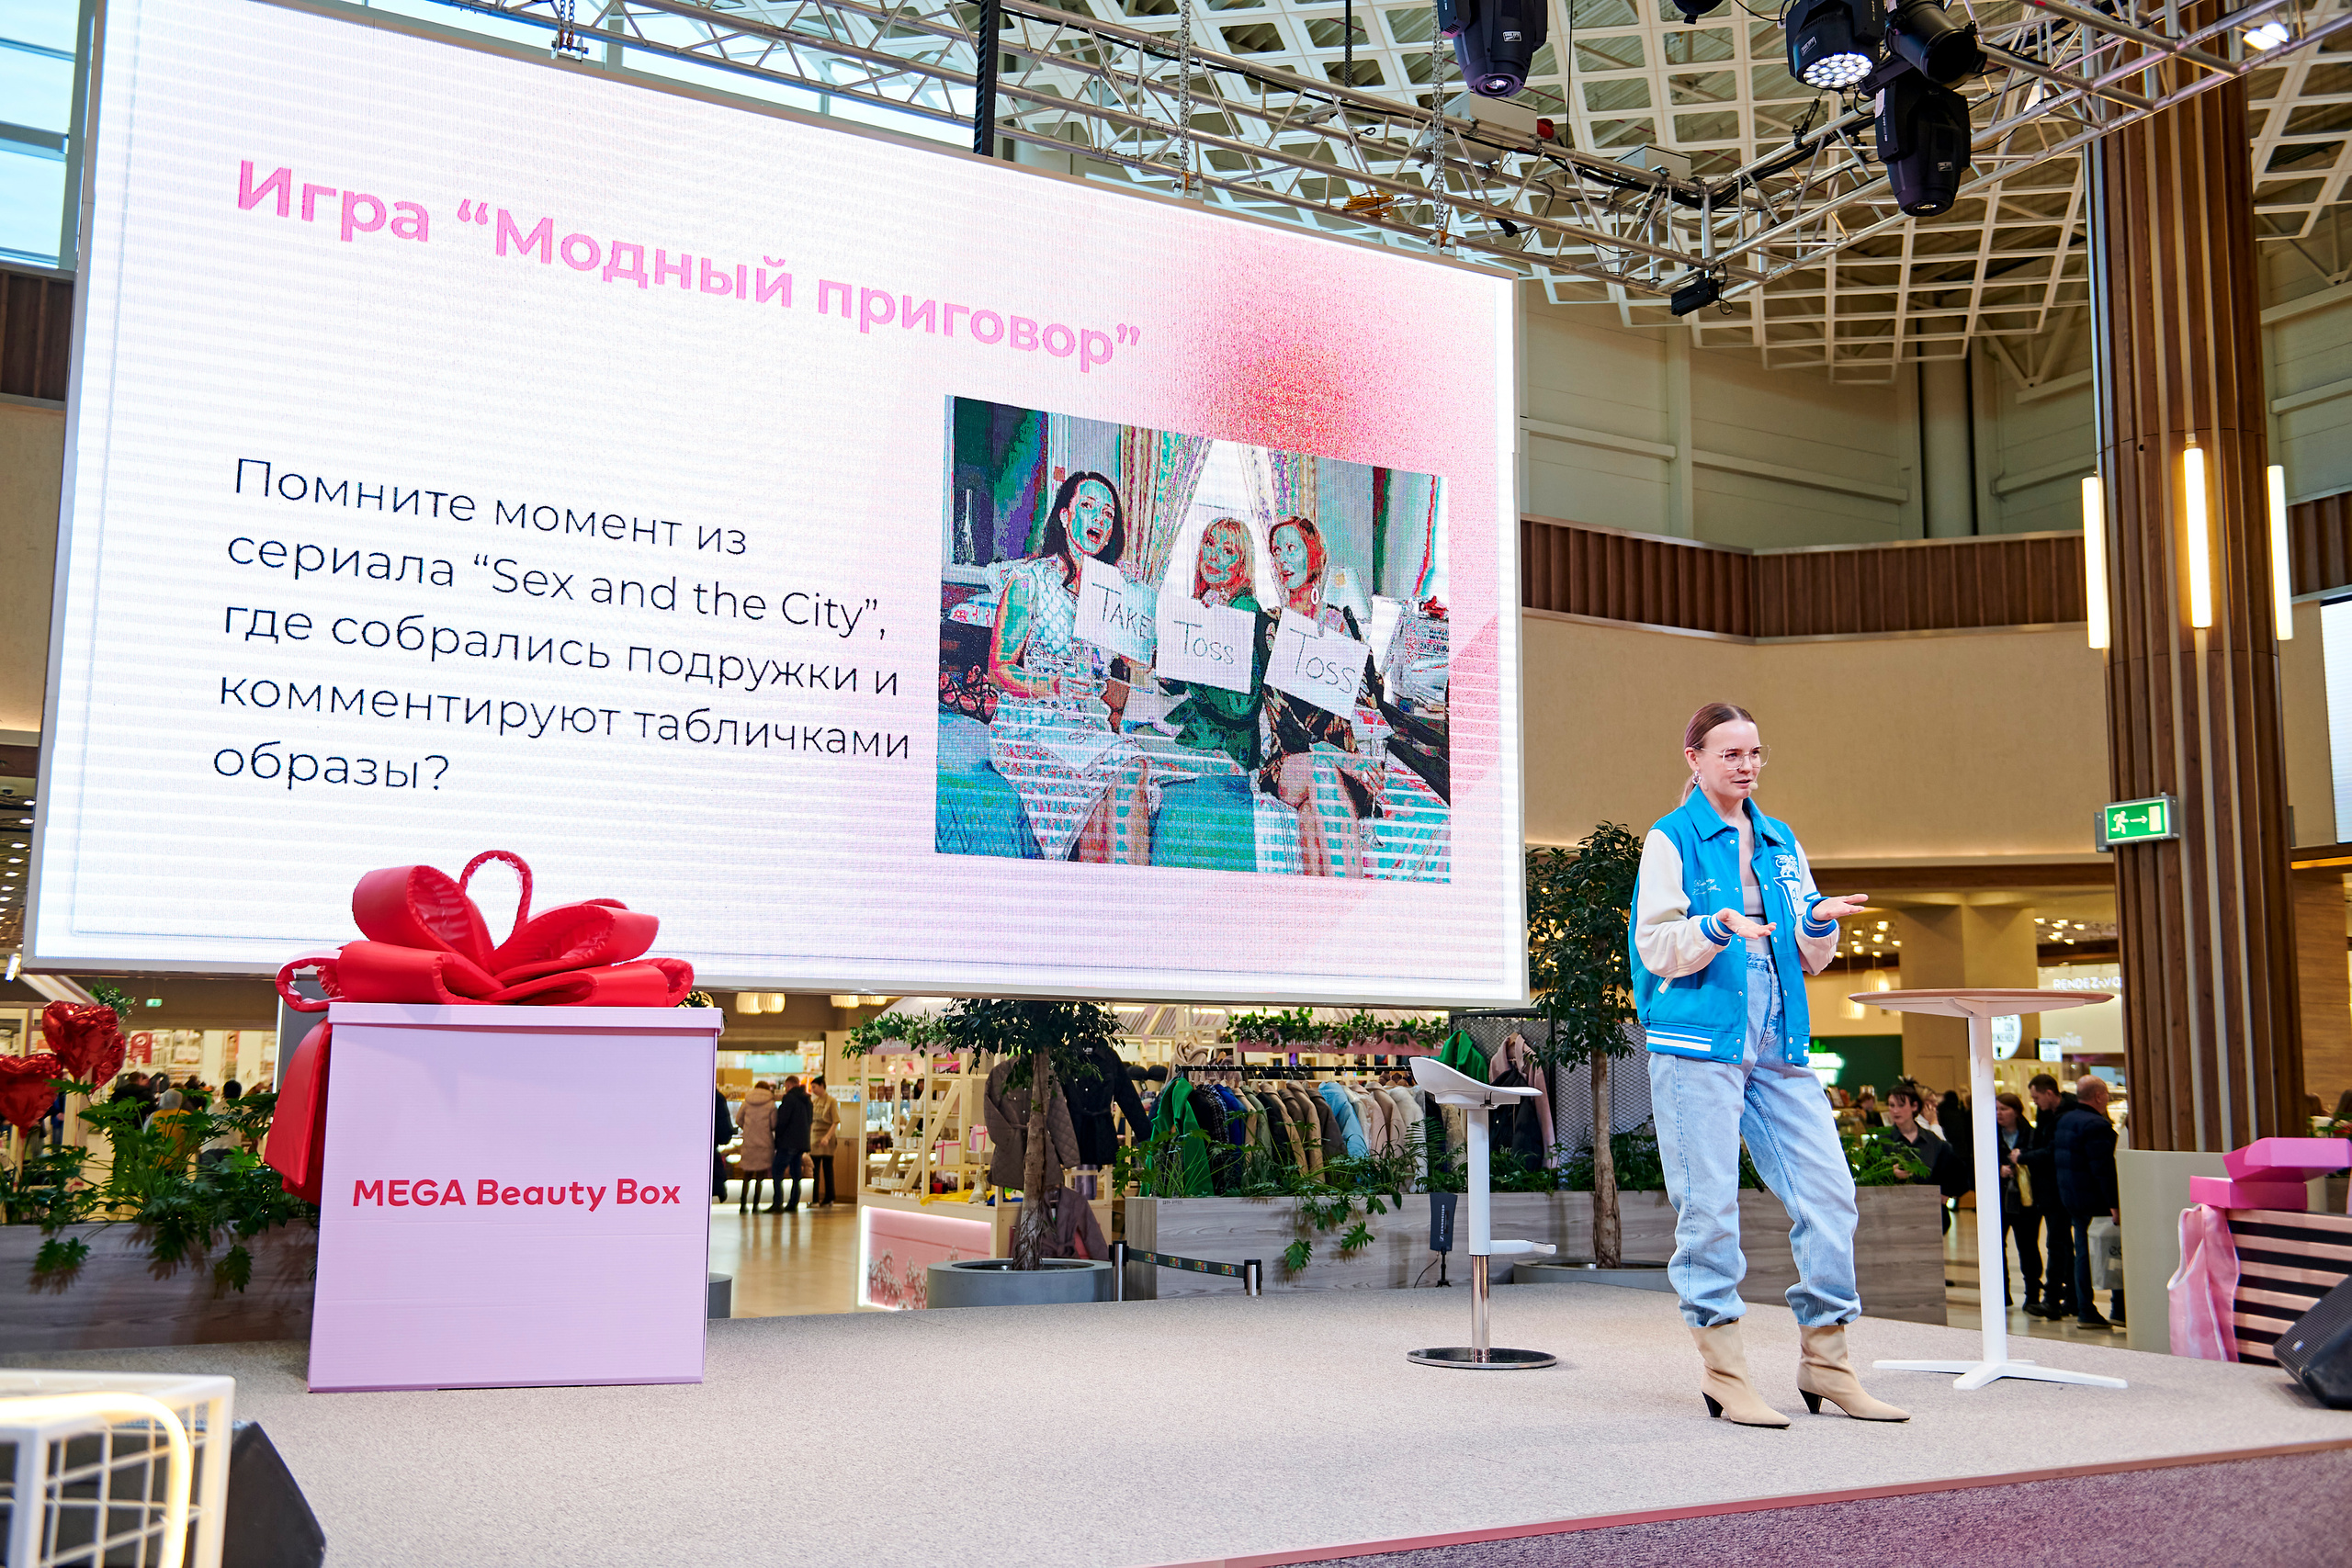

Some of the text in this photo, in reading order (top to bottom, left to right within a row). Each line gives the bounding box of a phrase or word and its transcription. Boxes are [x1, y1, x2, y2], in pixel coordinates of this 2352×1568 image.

[238, 159, 1141, 374] Игра “Модный приговор”
[236, 458, 746, 555] Помните момент из
[228, 537, 454, 588] сериала
[473, 555, 574, 599] “Sex
[591, 576, 676, 611] and
[694, 581, 767, 621] the
[1091, 581, 1153, 640] TAKE
[225, 606, 897, 695] где собрались подружки и
[220, 677, 909, 760] комментируют табличками
[213, 740, 449, 791] образы?
[354, 1178, 681, 1213] MEGA Beauty Box
